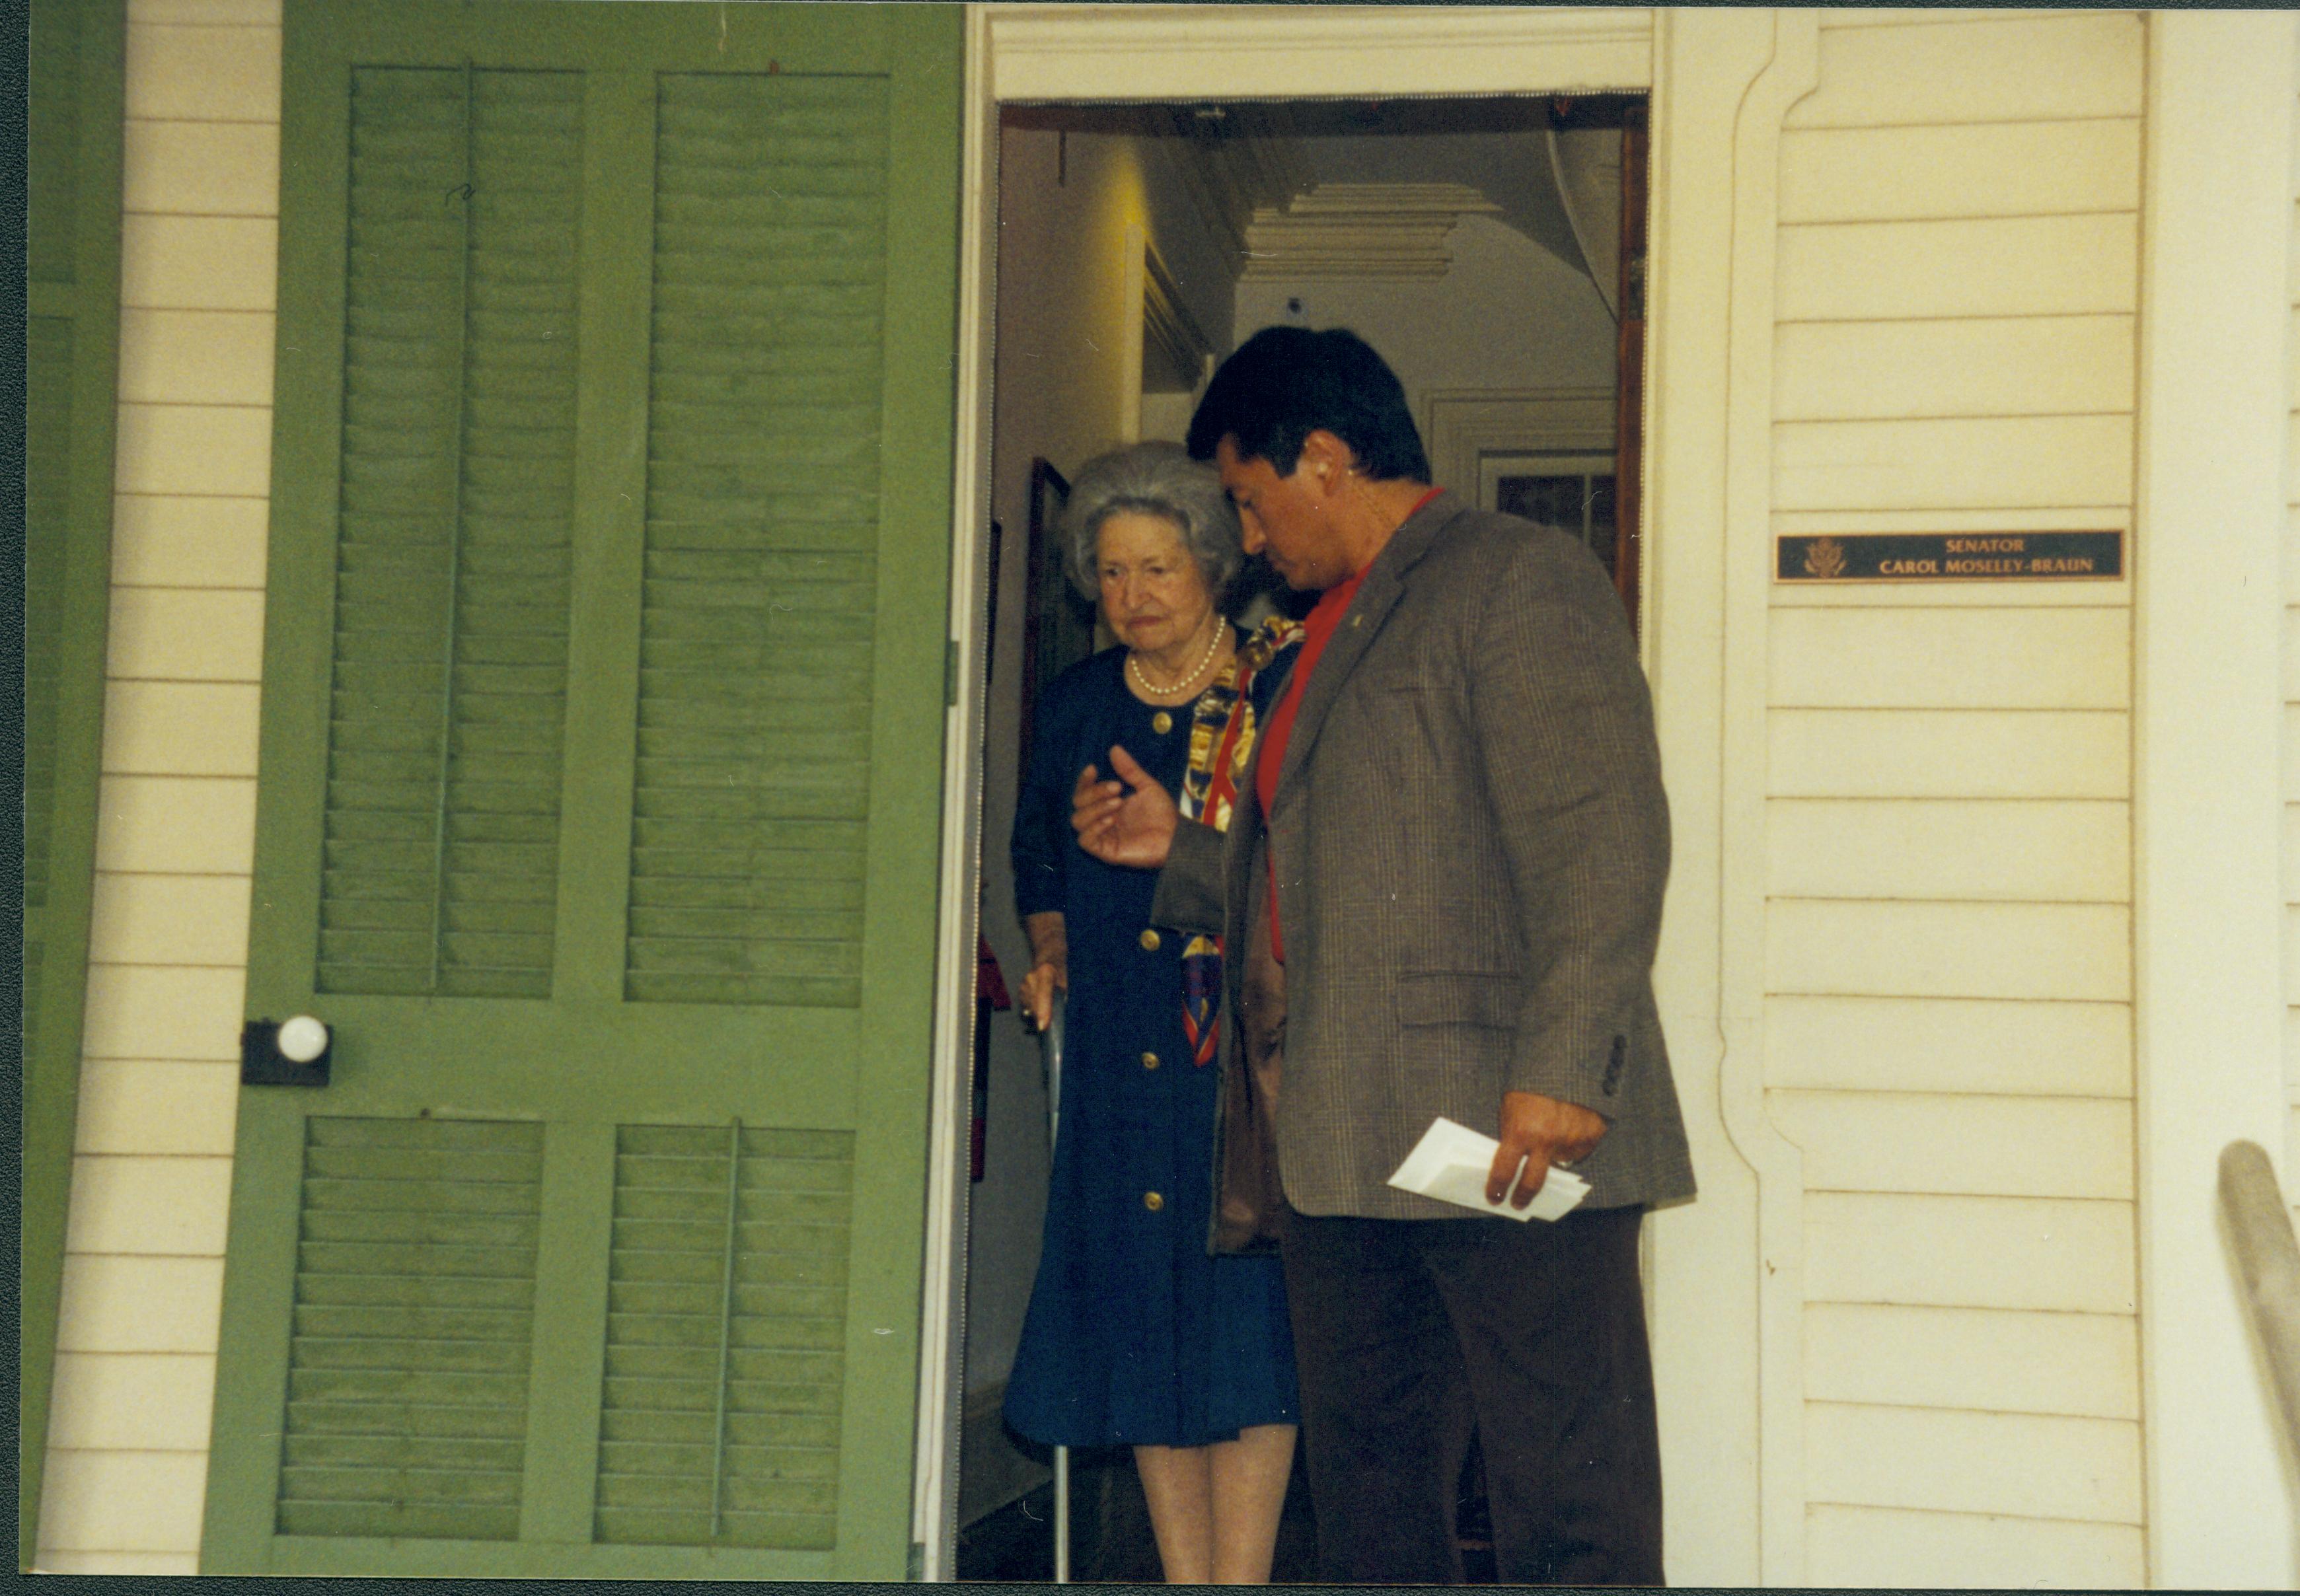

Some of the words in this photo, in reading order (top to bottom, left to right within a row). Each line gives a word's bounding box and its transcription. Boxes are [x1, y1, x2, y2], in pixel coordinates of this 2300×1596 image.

[1946, 538, 2024, 552] SENATOR
[1879, 560, 1939, 573] CAROL
[1945, 558, 2093, 573] MOSELEY-BRAUN
